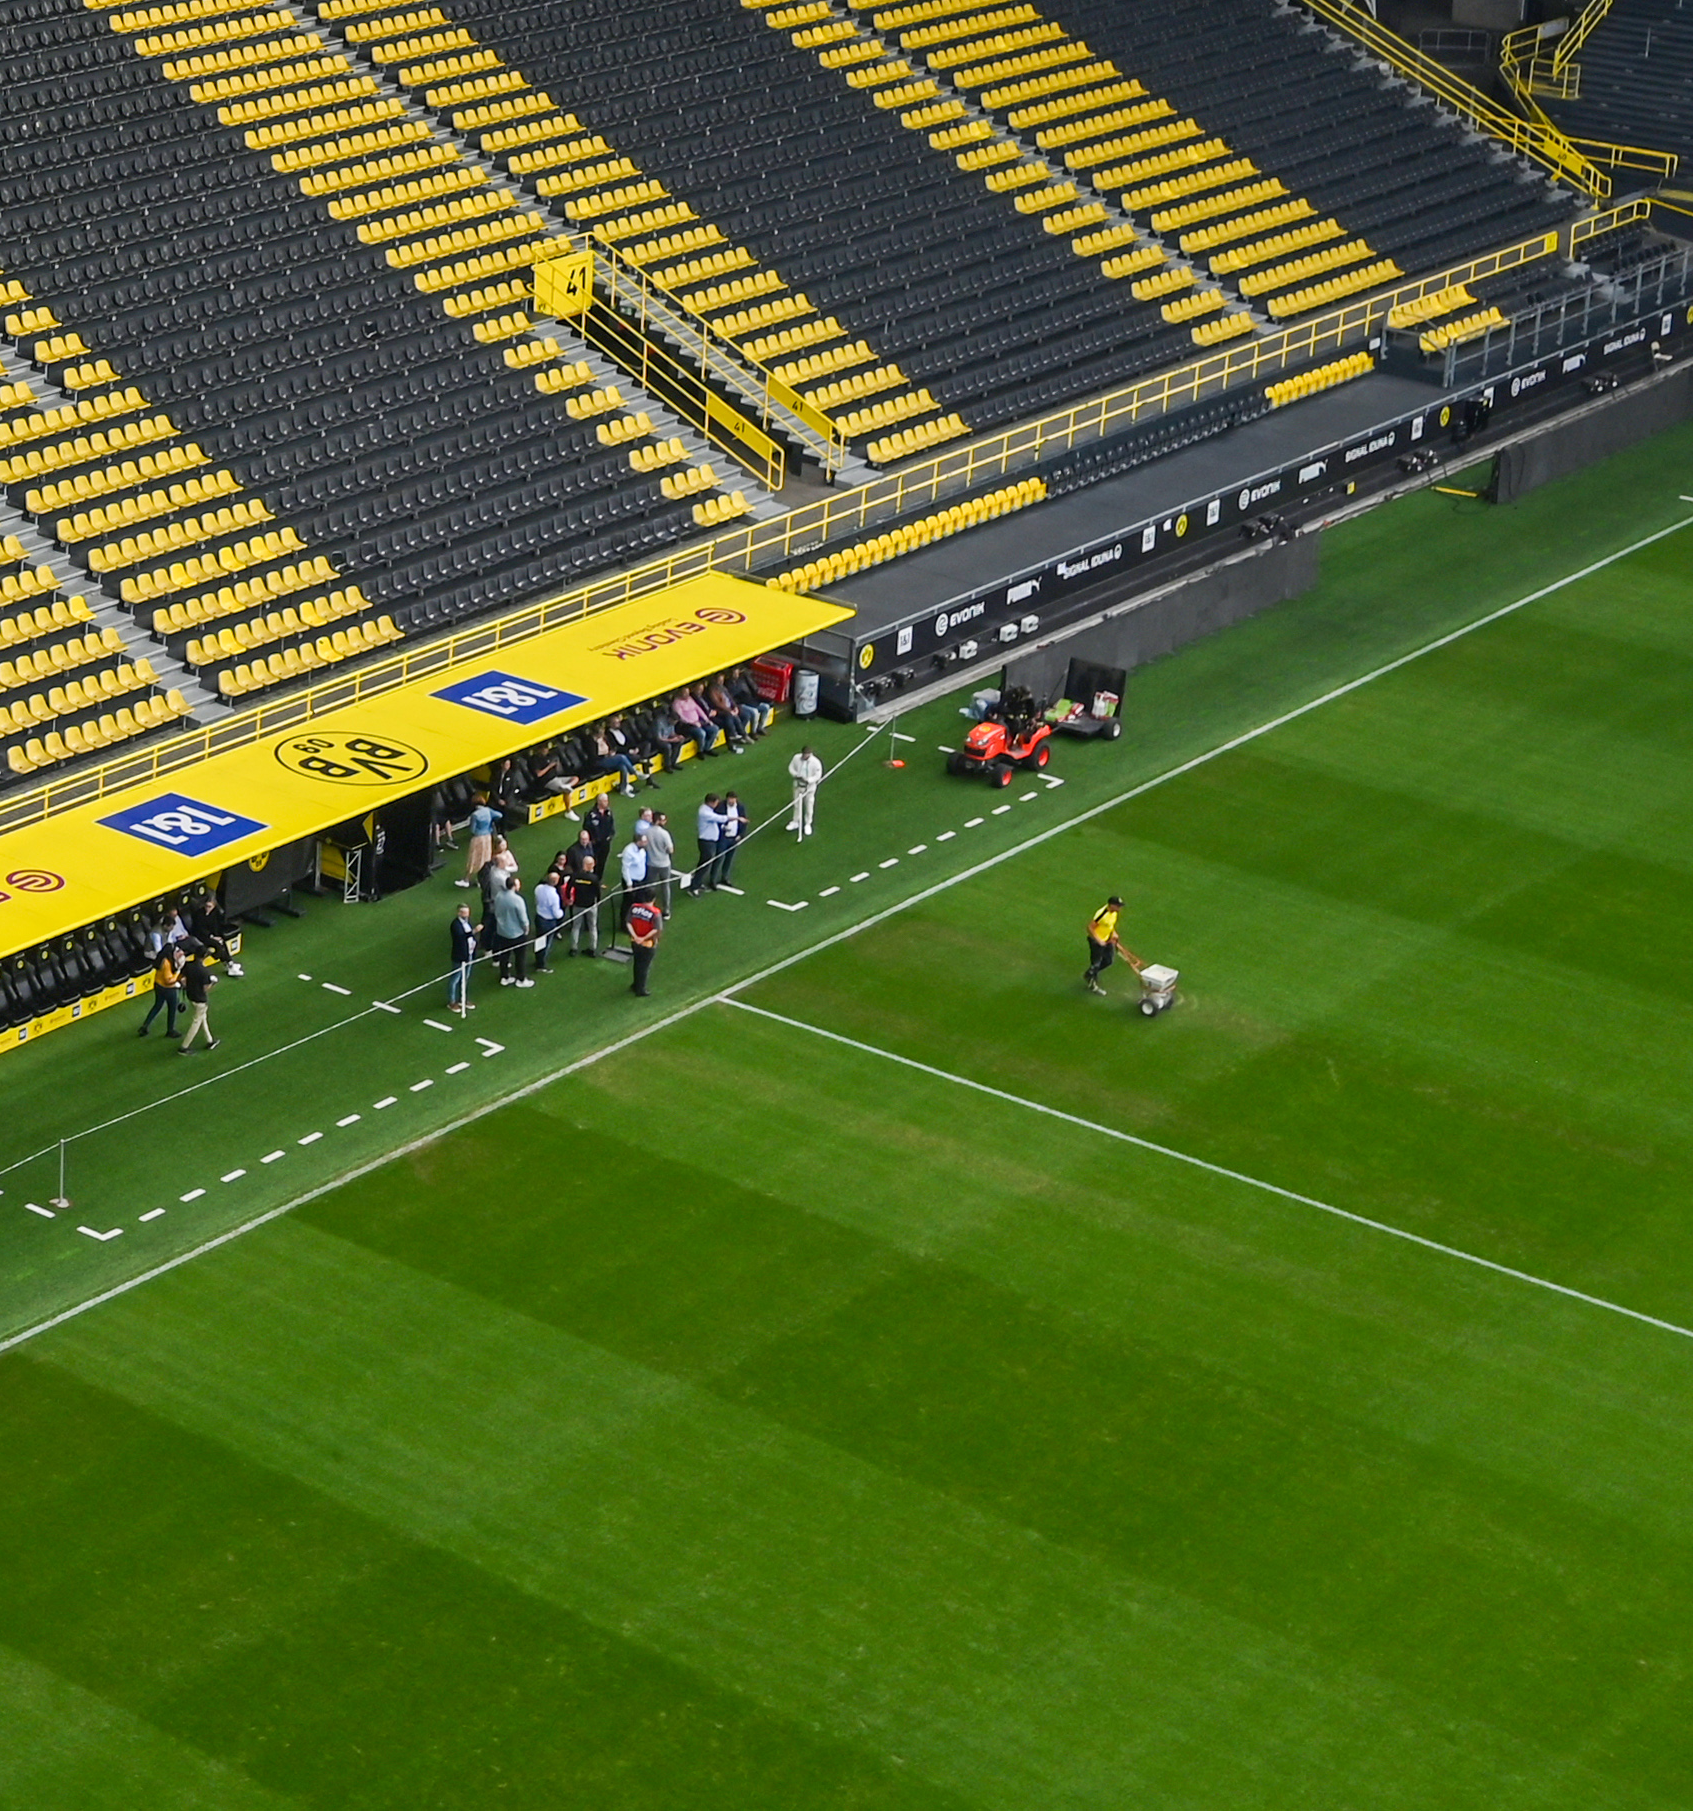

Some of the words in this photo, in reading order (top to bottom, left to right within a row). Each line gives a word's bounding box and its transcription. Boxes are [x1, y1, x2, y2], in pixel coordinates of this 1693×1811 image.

[567, 267, 586, 296] 41
[792, 401, 803, 412] 41
[734, 422, 745, 433] 41
[949, 602, 986, 628] EVONIK
[602, 622, 707, 660] EVONIK
[461, 681, 558, 715] 1&1
[292, 738, 335, 754] 09
[298, 737, 413, 780] BVB
[133, 805, 235, 845] 1&1
